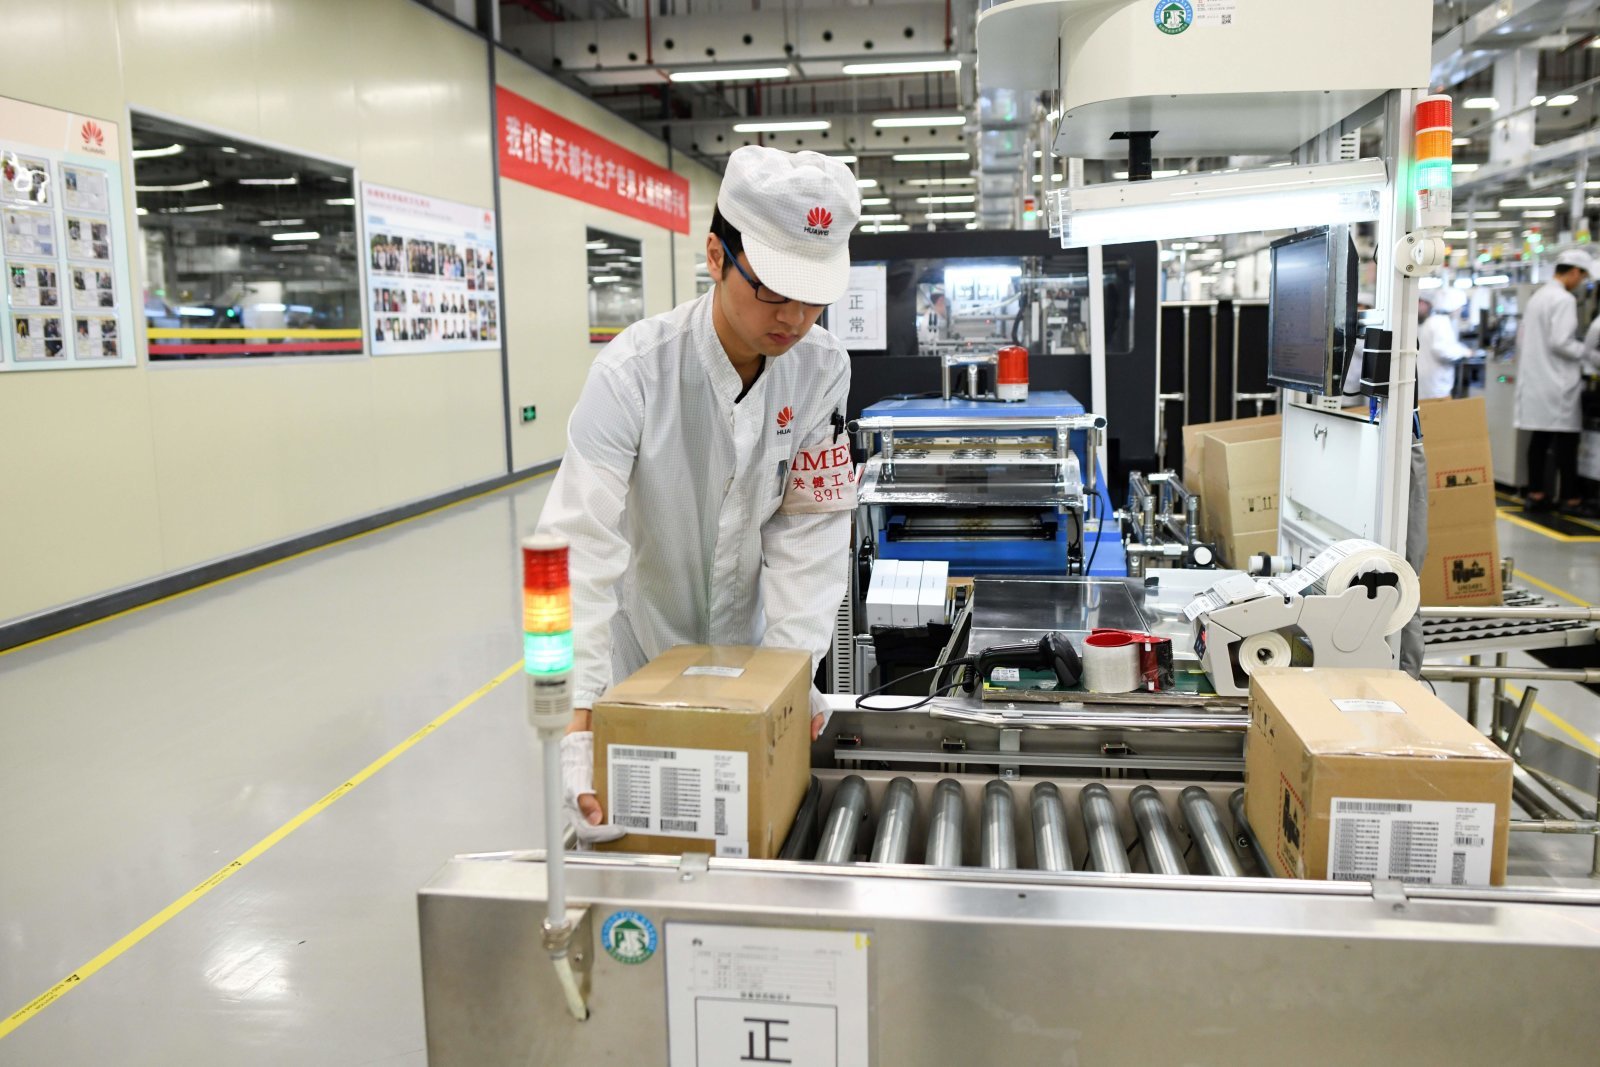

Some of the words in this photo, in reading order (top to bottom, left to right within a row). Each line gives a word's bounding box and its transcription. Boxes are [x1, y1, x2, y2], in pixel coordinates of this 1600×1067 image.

[804, 226, 830, 236] HUAWEI
[848, 294, 865, 333] 正常
[813, 488, 843, 503] 891
[740, 1016, 792, 1064] 正
